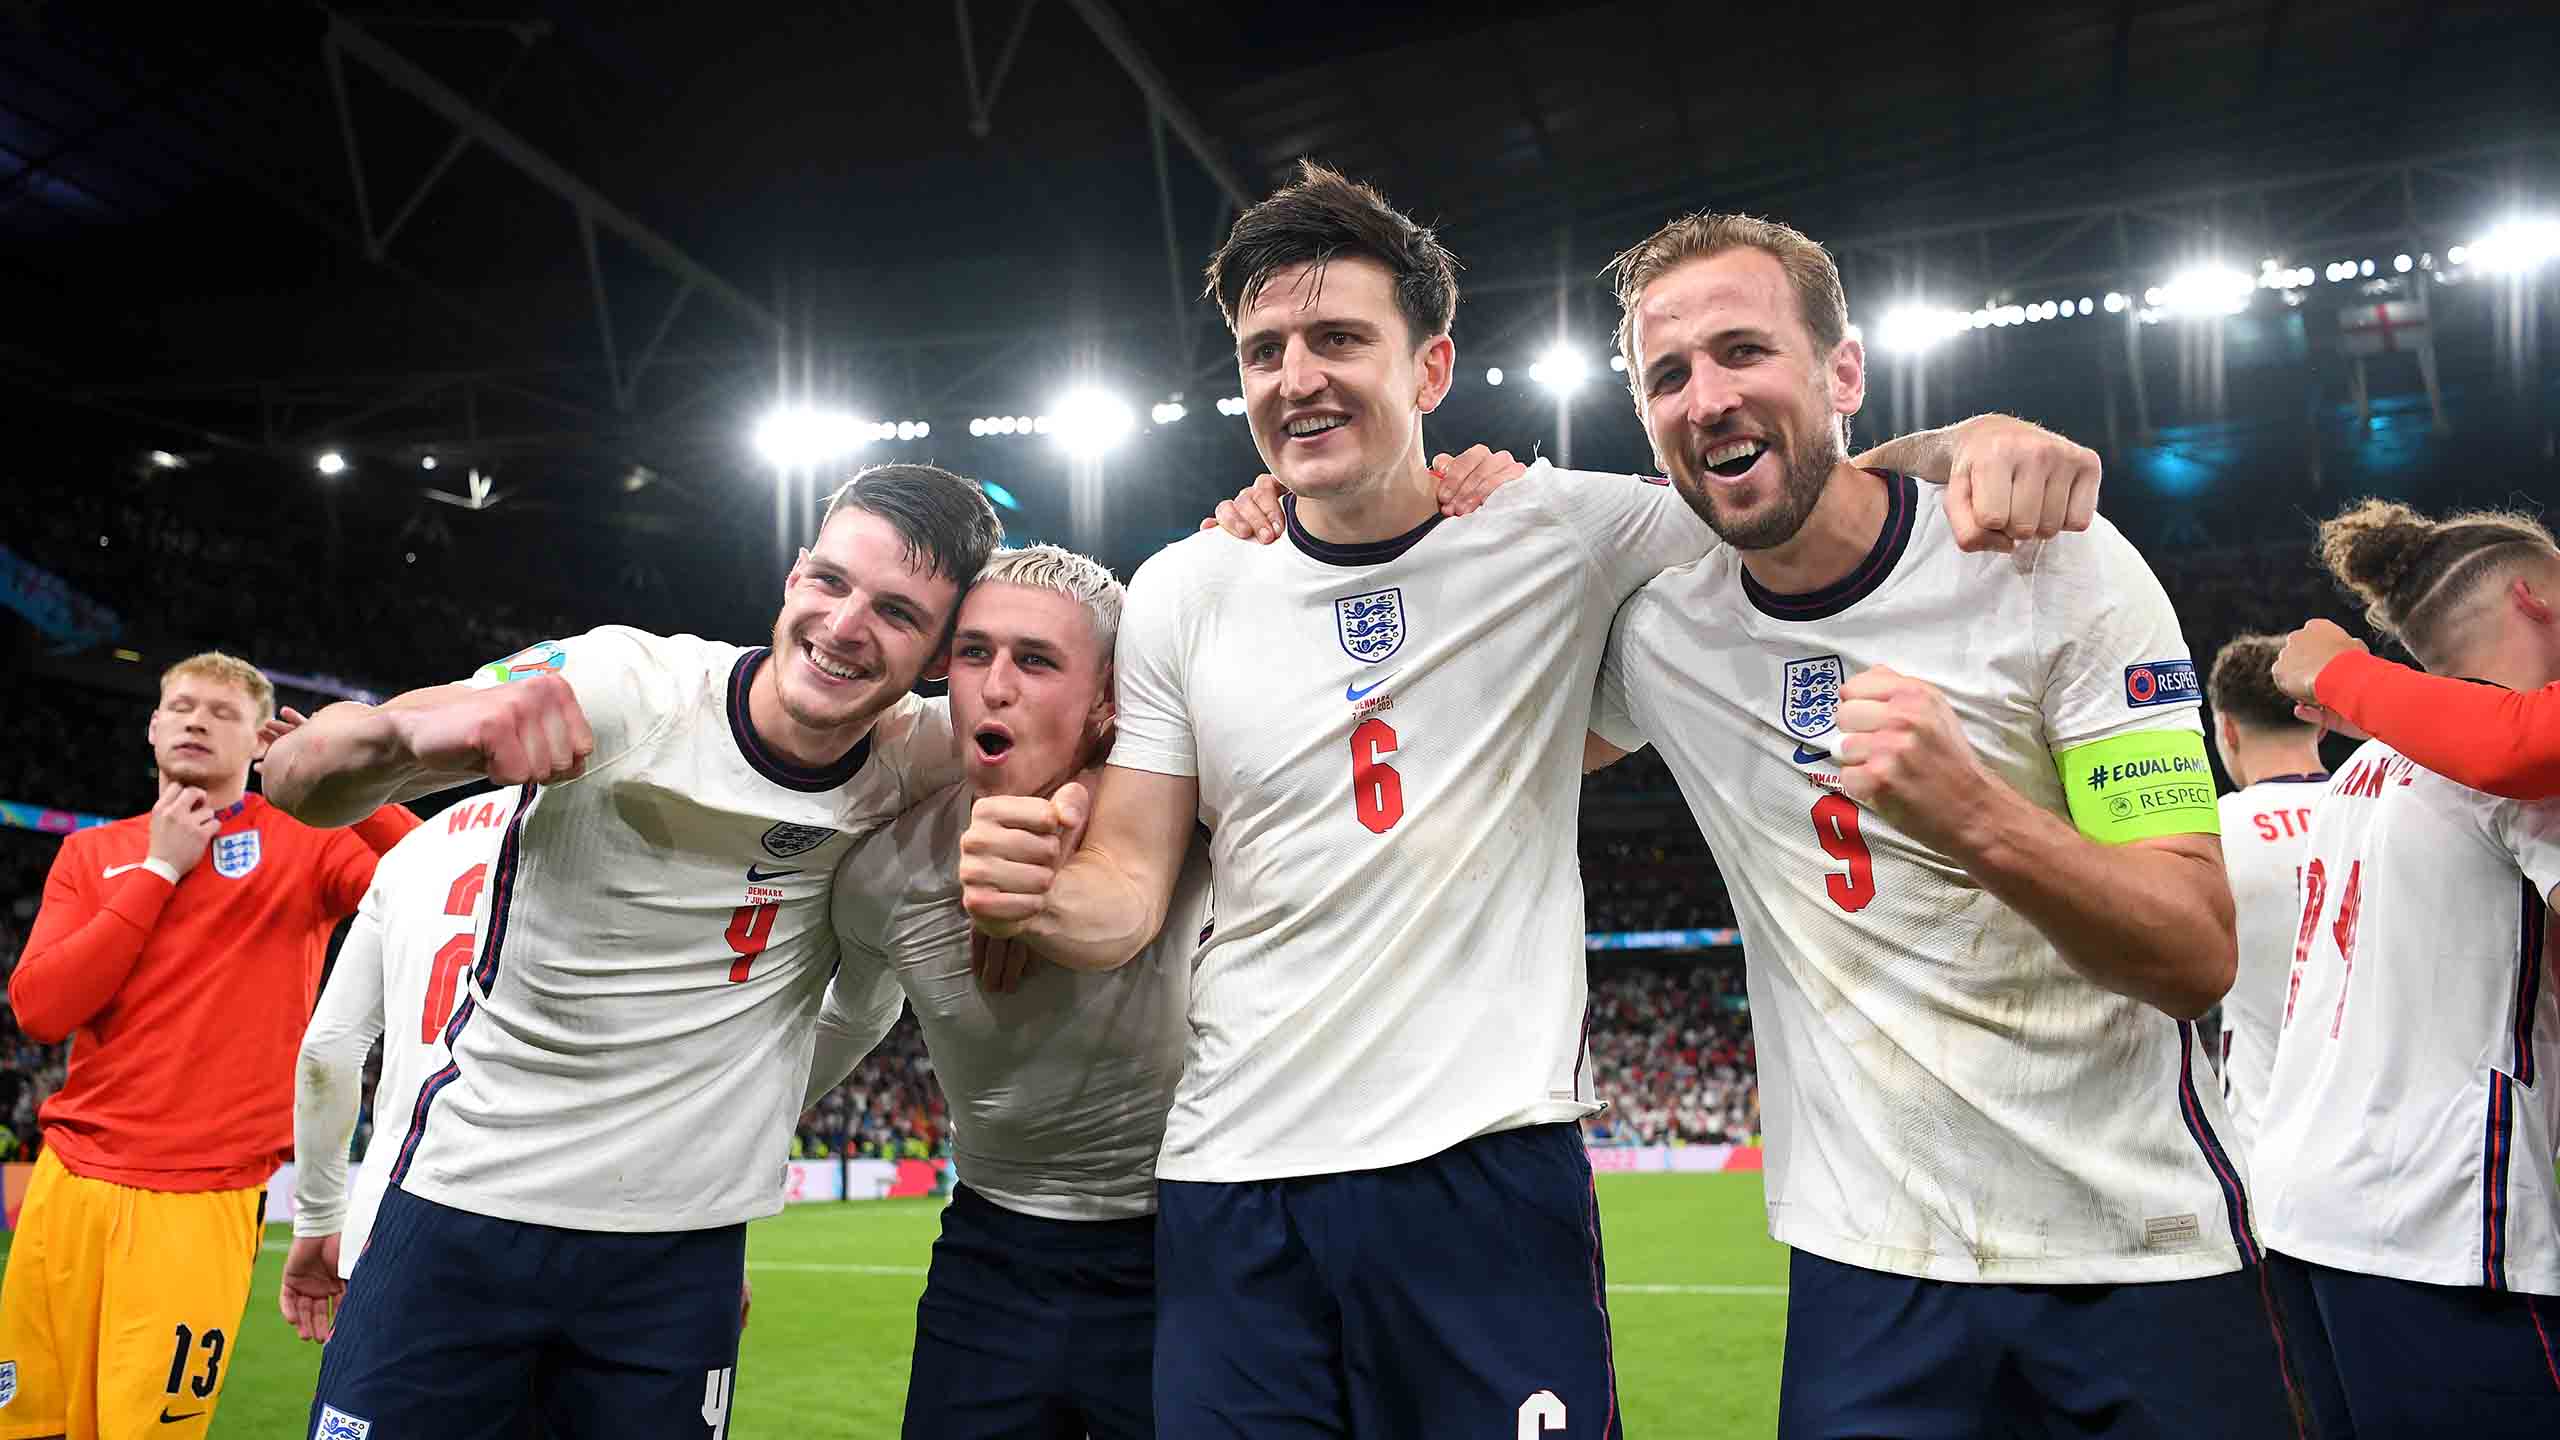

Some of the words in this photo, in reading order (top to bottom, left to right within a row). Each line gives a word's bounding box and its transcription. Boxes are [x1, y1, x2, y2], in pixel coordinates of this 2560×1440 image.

[1377, 700, 1394, 711] 2021
[2158, 672, 2199, 691] RESPEC
[1350, 718, 1404, 834] 6
[1811, 791, 1876, 912] 9
[748, 887, 783, 897] DENMARK
[724, 904, 780, 984] 4
[166, 1324, 225, 1398] 13
[701, 1367, 732, 1440] 4
